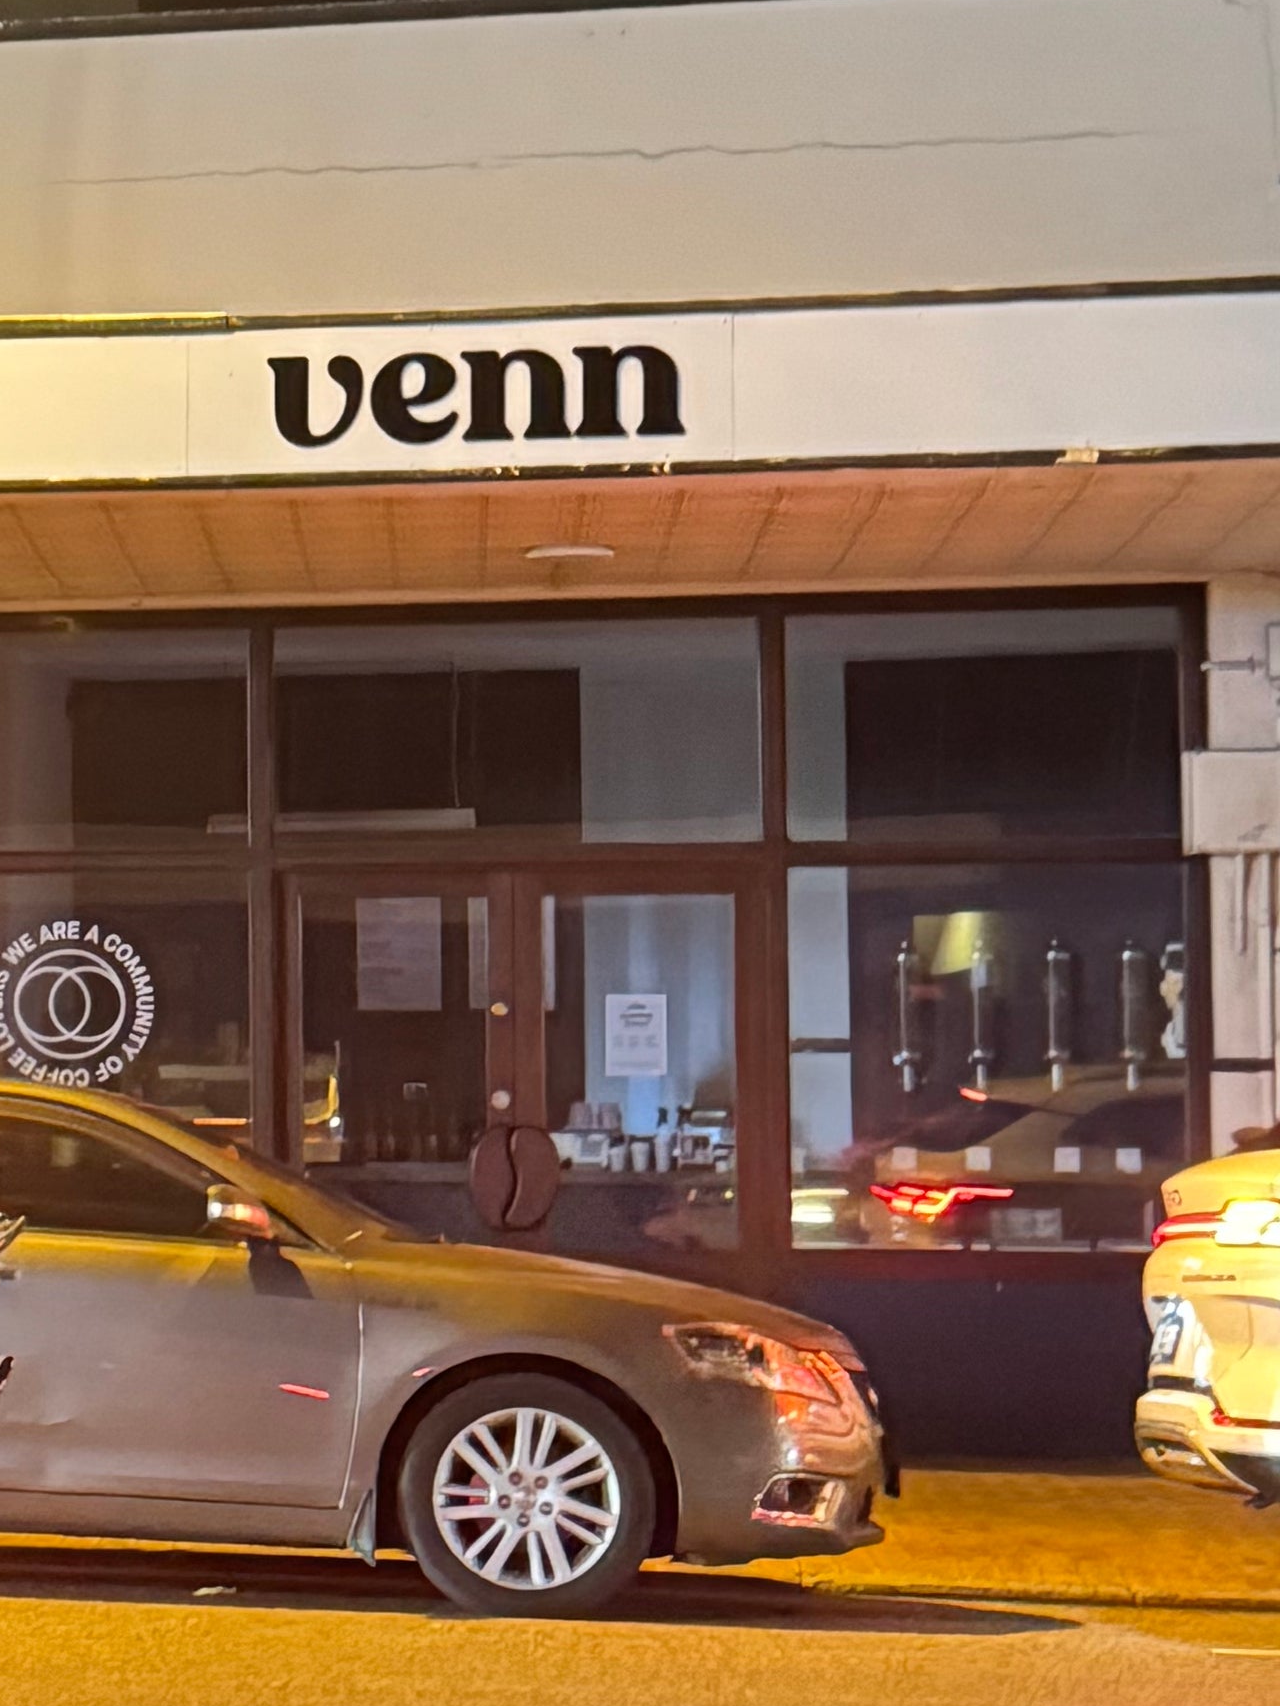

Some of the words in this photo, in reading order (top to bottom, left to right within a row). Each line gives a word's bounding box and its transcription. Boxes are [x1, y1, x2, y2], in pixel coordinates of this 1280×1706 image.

[267, 345, 686, 448] venn
[39, 920, 80, 945] ARE
[83, 925, 100, 945] A
[2, 933, 37, 966] WE
[103, 934, 155, 1062] COMMUNITY
[8, 1047, 90, 1087] COFFEE
[95, 1055, 123, 1083] OF
